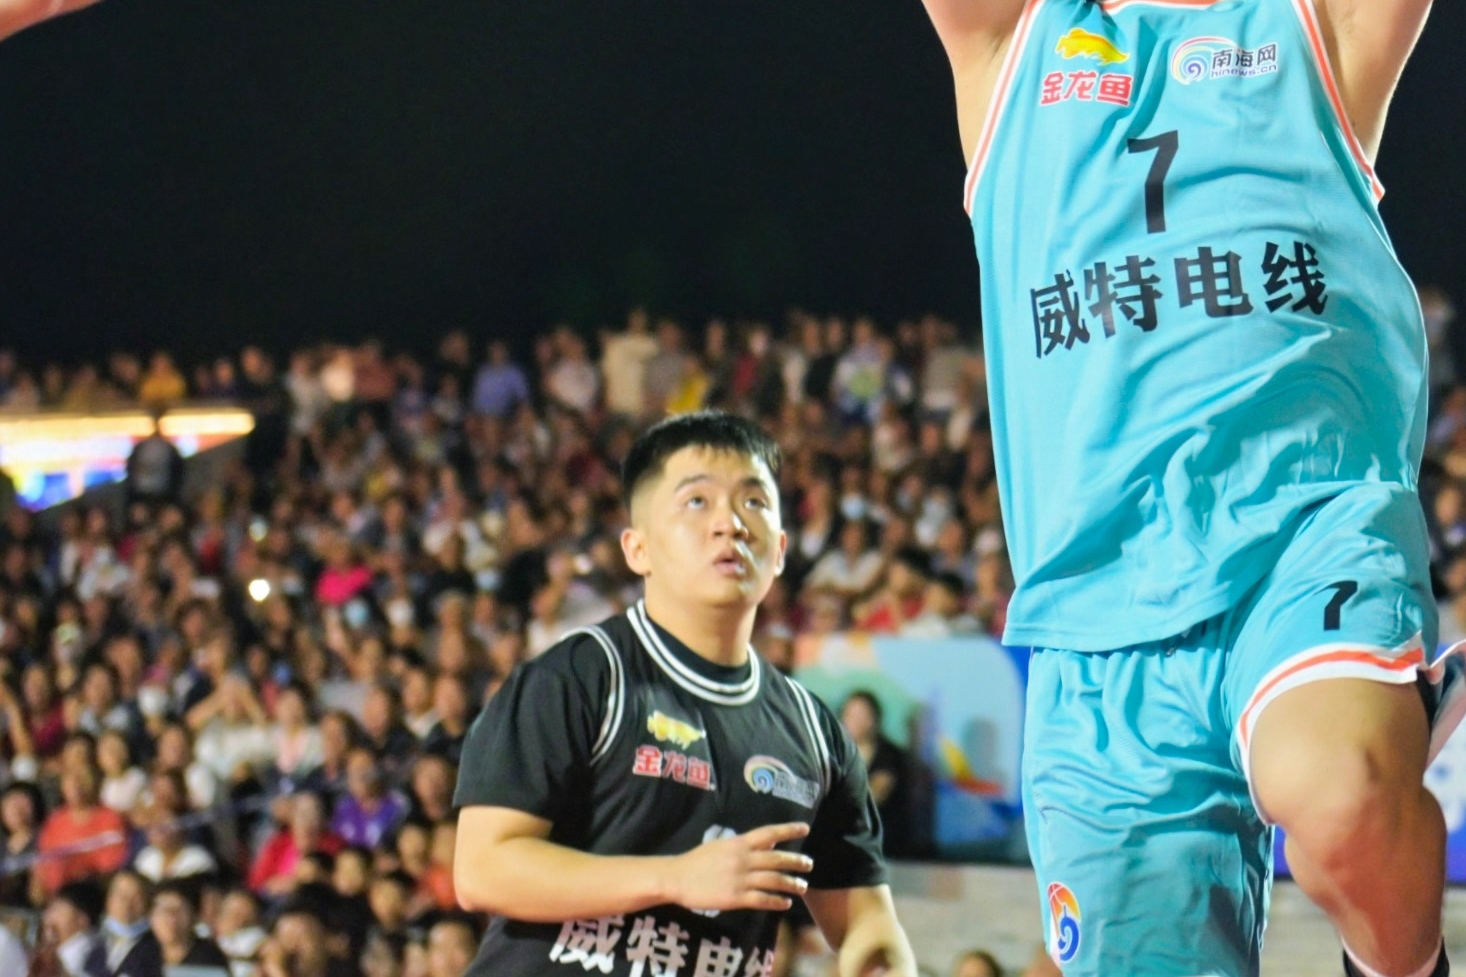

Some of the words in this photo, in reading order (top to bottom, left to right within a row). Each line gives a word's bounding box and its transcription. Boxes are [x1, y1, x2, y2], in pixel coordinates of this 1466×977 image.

[1210, 64, 1277, 78] hinews.cn
[1211, 43, 1277, 70] 南海网
[1040, 72, 1133, 106] 金龙鱼
[1127, 129, 1179, 235] 7
[1030, 240, 1329, 360] 威特电线
[1315, 580, 1358, 631] 7
